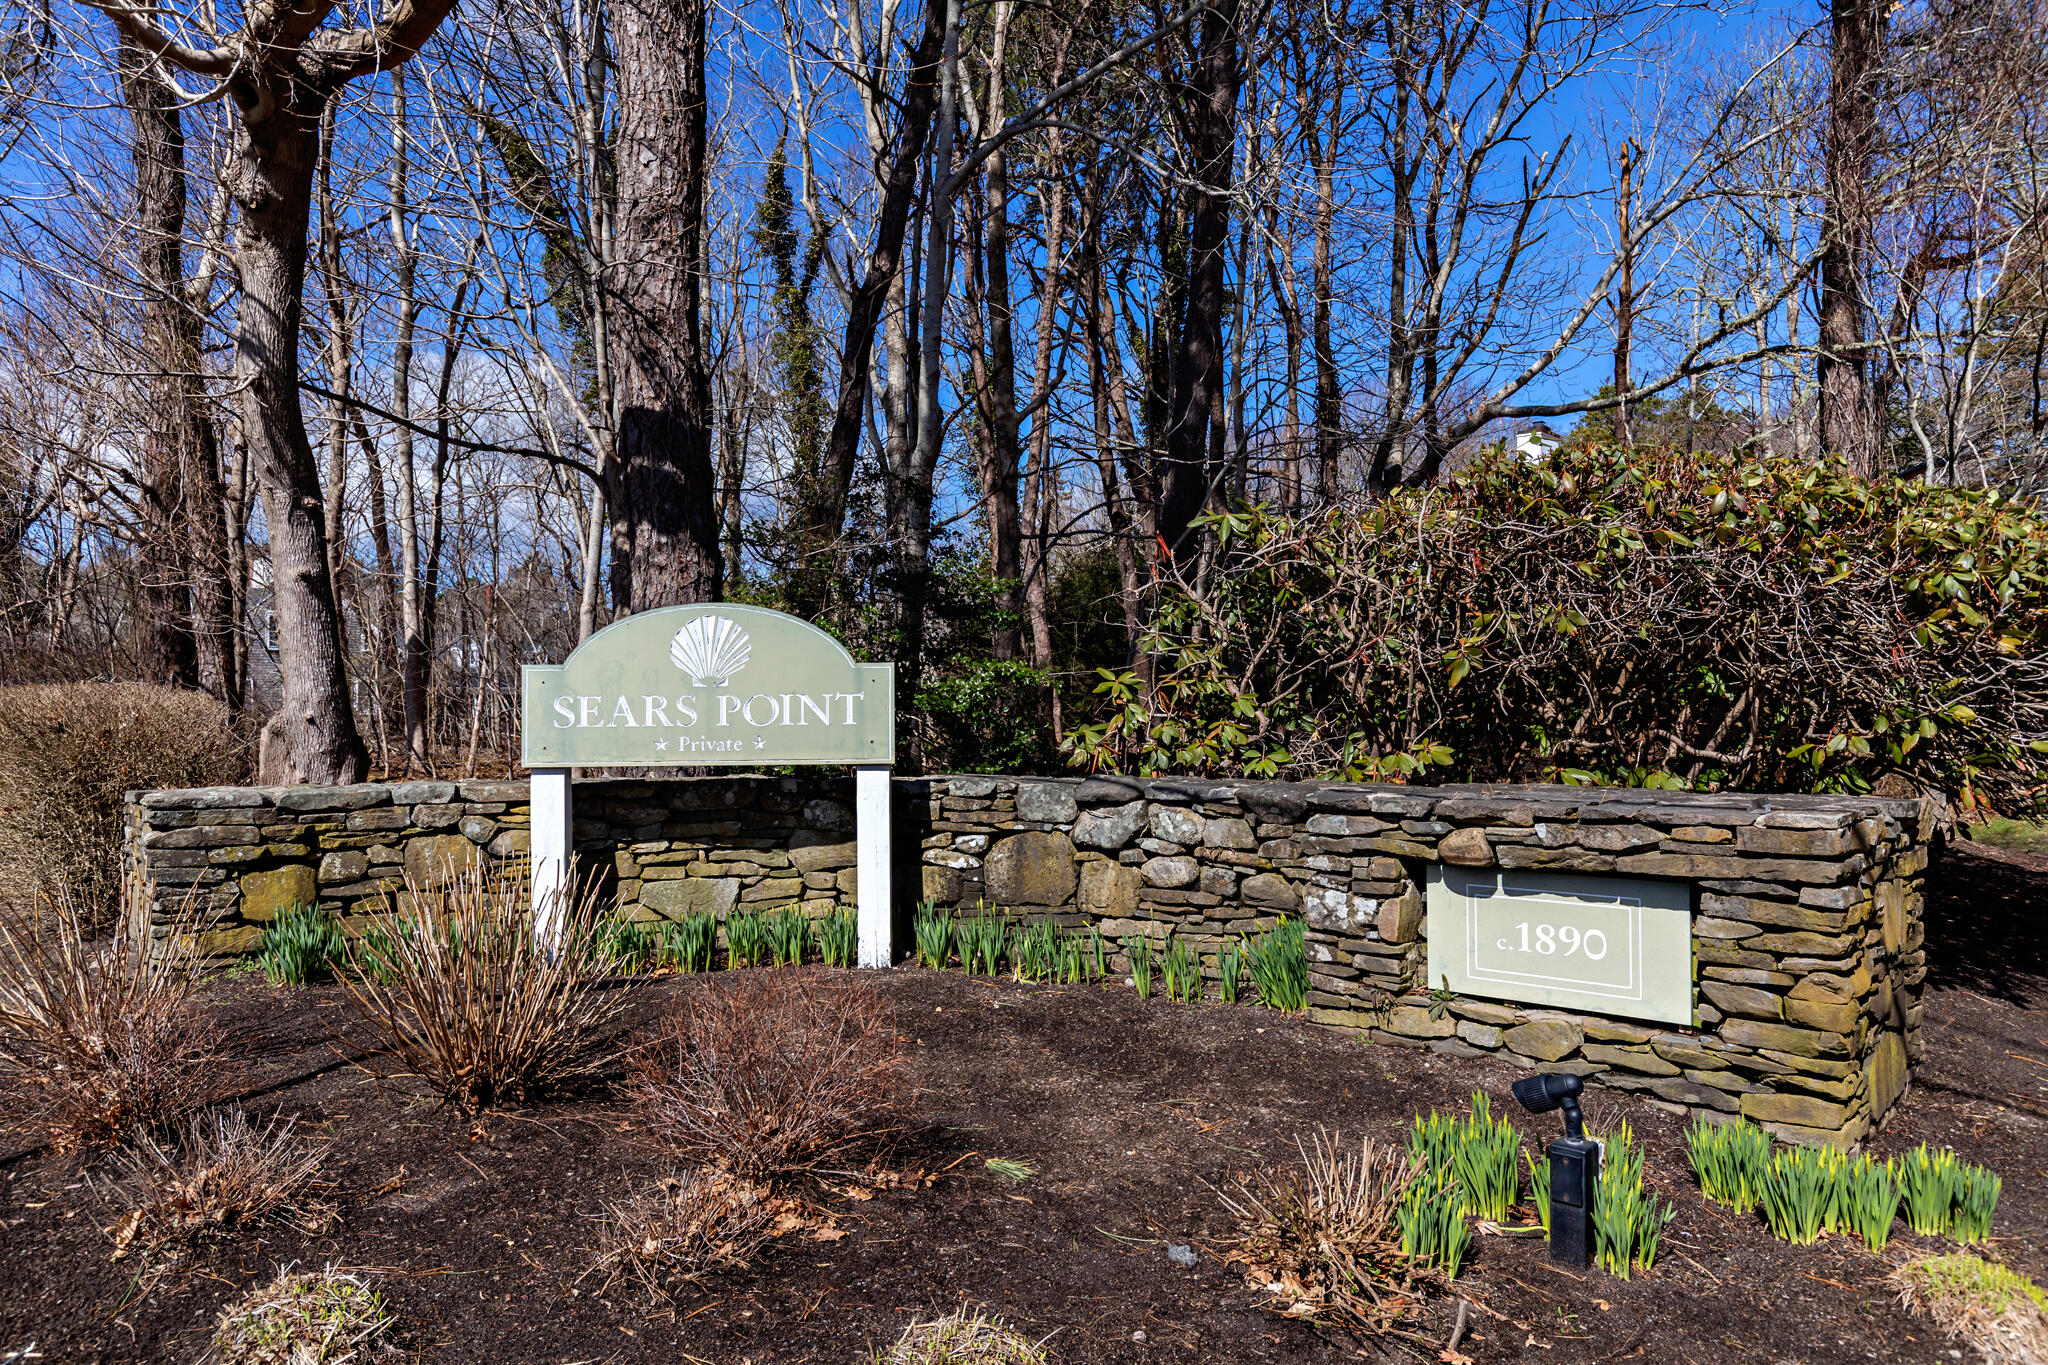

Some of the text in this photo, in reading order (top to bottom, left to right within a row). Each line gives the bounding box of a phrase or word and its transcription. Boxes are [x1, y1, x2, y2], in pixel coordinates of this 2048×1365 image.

[552, 691, 865, 729] SEARS POINT
[677, 735, 743, 753] Private
[1496, 922, 1608, 961] c.1890
